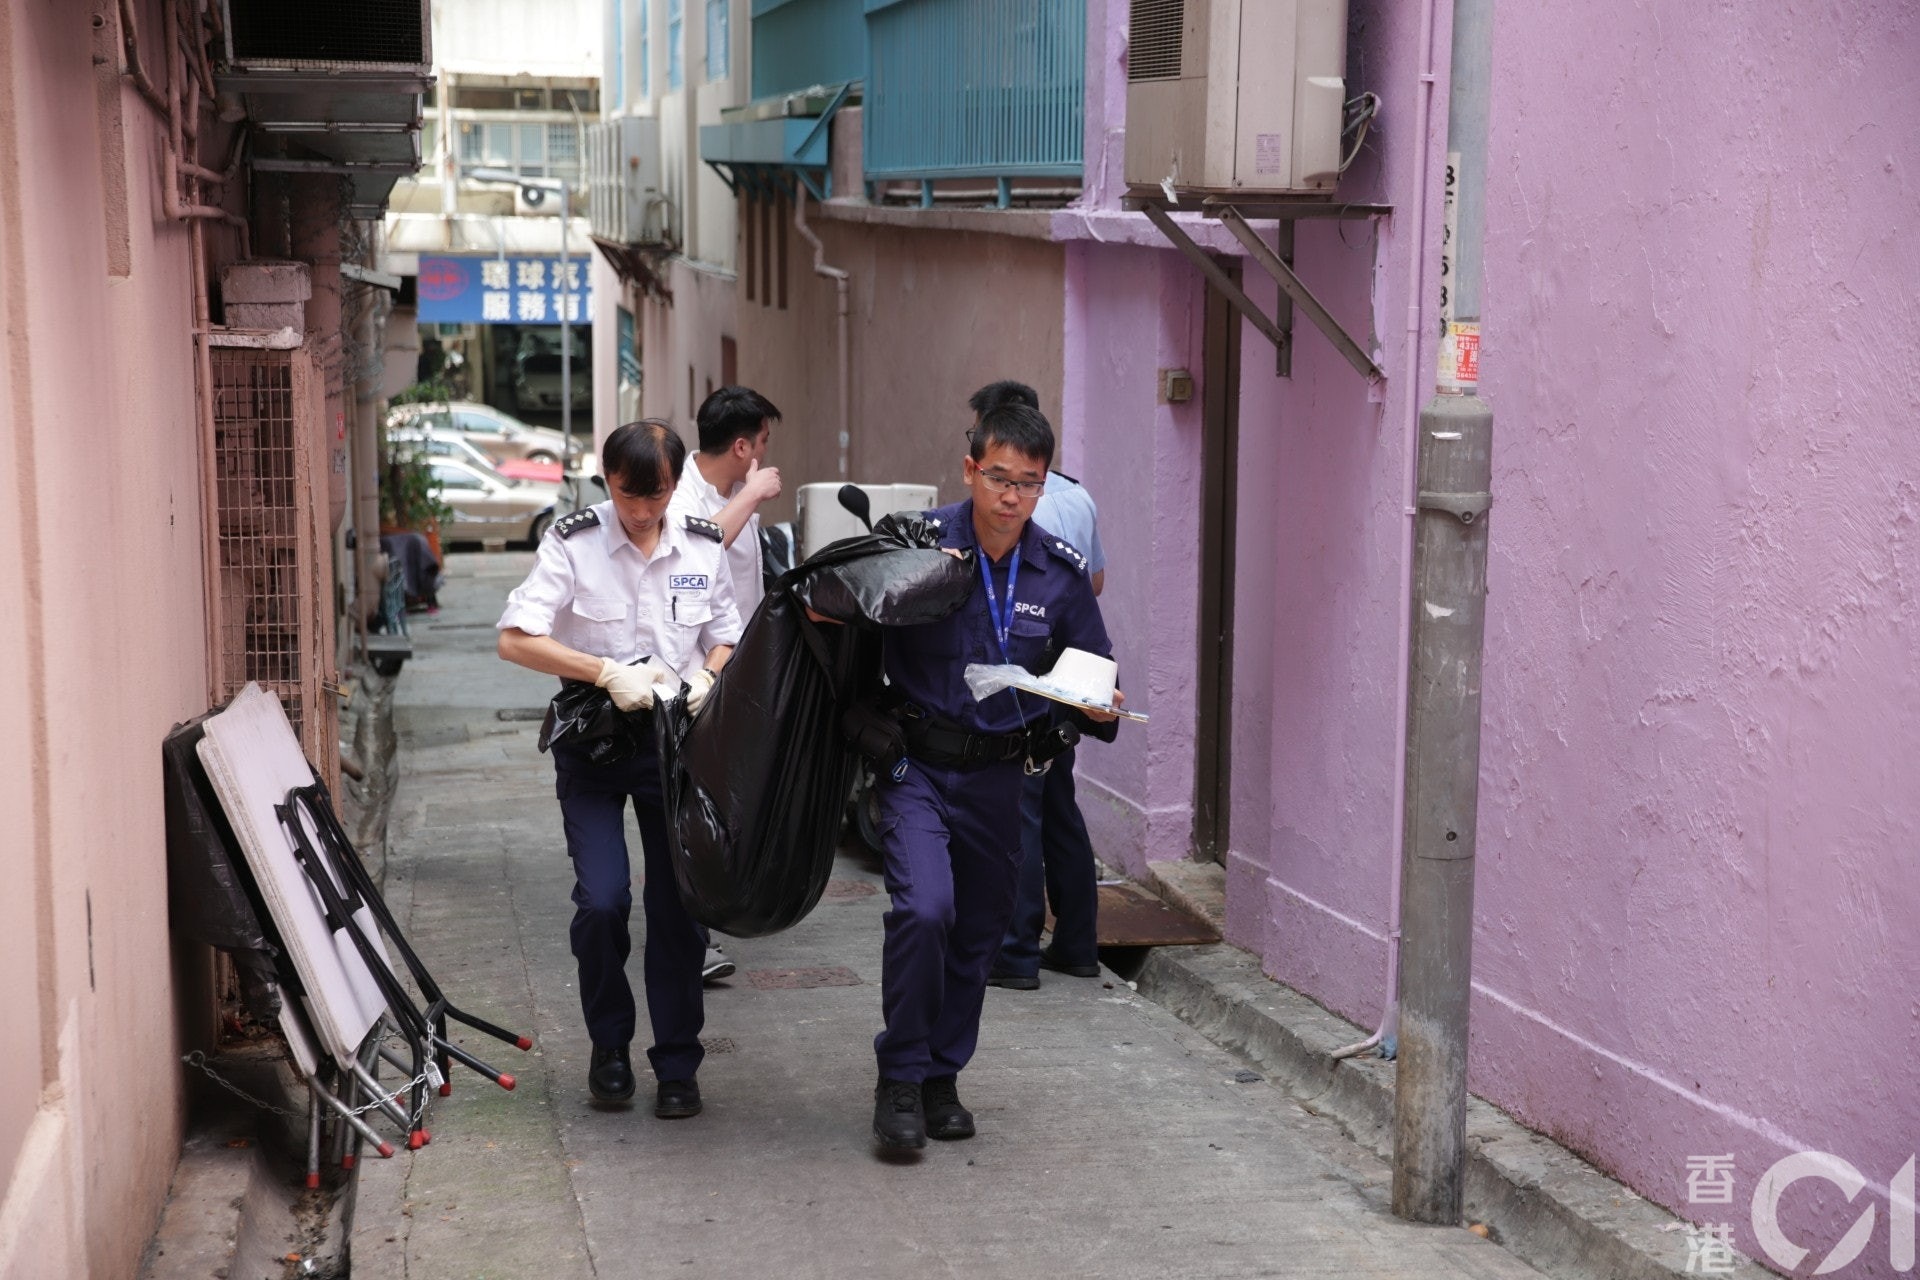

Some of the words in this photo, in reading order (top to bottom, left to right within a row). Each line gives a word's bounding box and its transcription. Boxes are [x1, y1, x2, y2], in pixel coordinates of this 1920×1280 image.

[481, 260, 592, 290] 環球汽
[482, 291, 594, 321] 服務有
[673, 577, 705, 587] SPCA
[1014, 602, 1045, 617] SPCA
